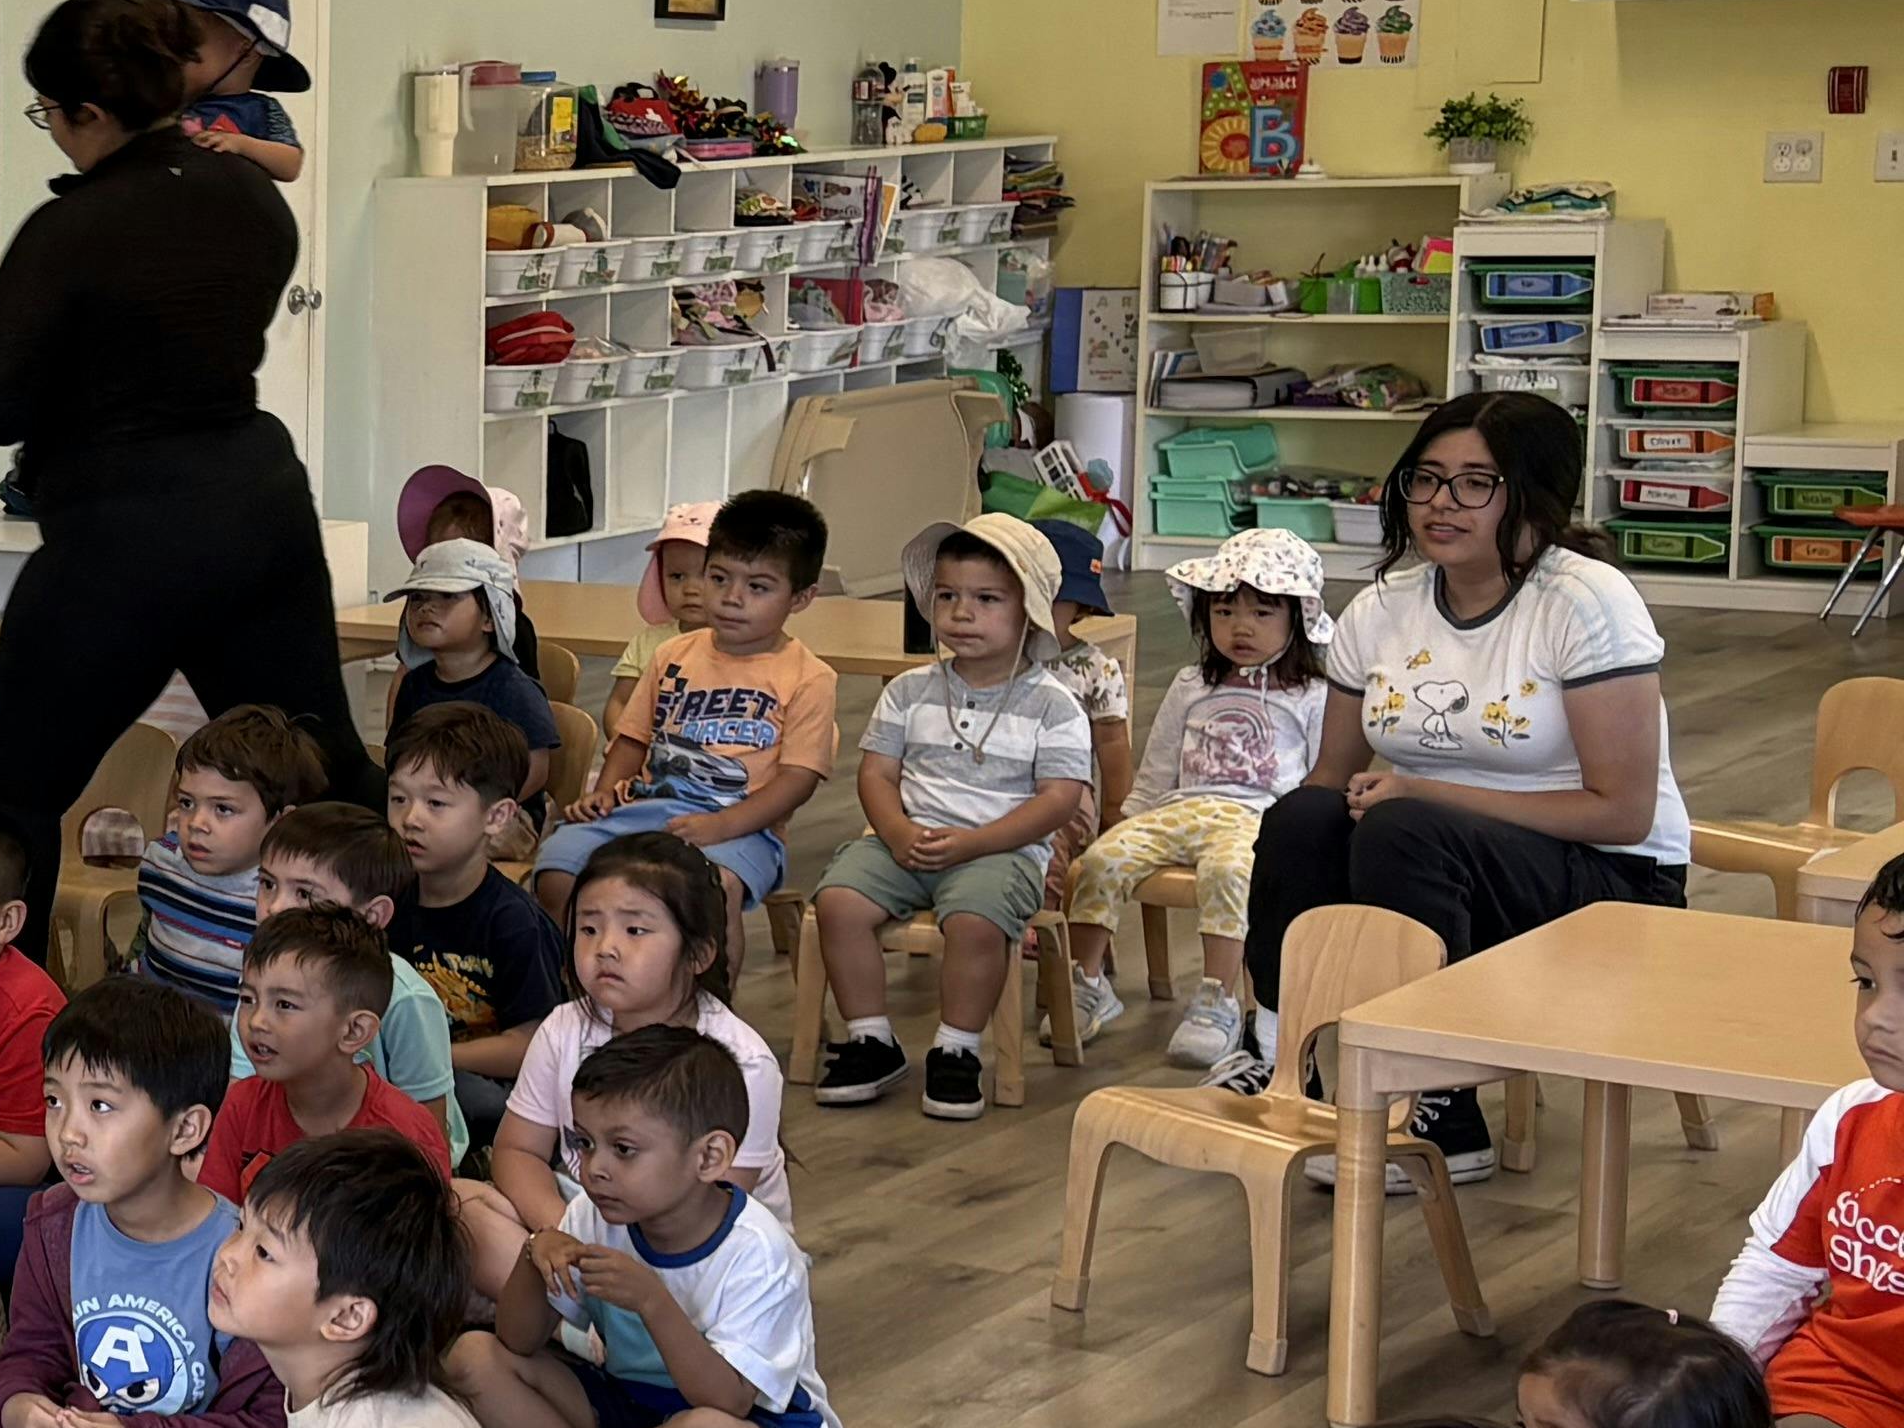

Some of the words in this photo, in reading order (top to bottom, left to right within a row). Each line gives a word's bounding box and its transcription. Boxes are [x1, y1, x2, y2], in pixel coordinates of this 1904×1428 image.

[682, 720, 777, 749] RACER
[108, 1294, 196, 1356] AMERICA
[91, 1326, 149, 1373] A
